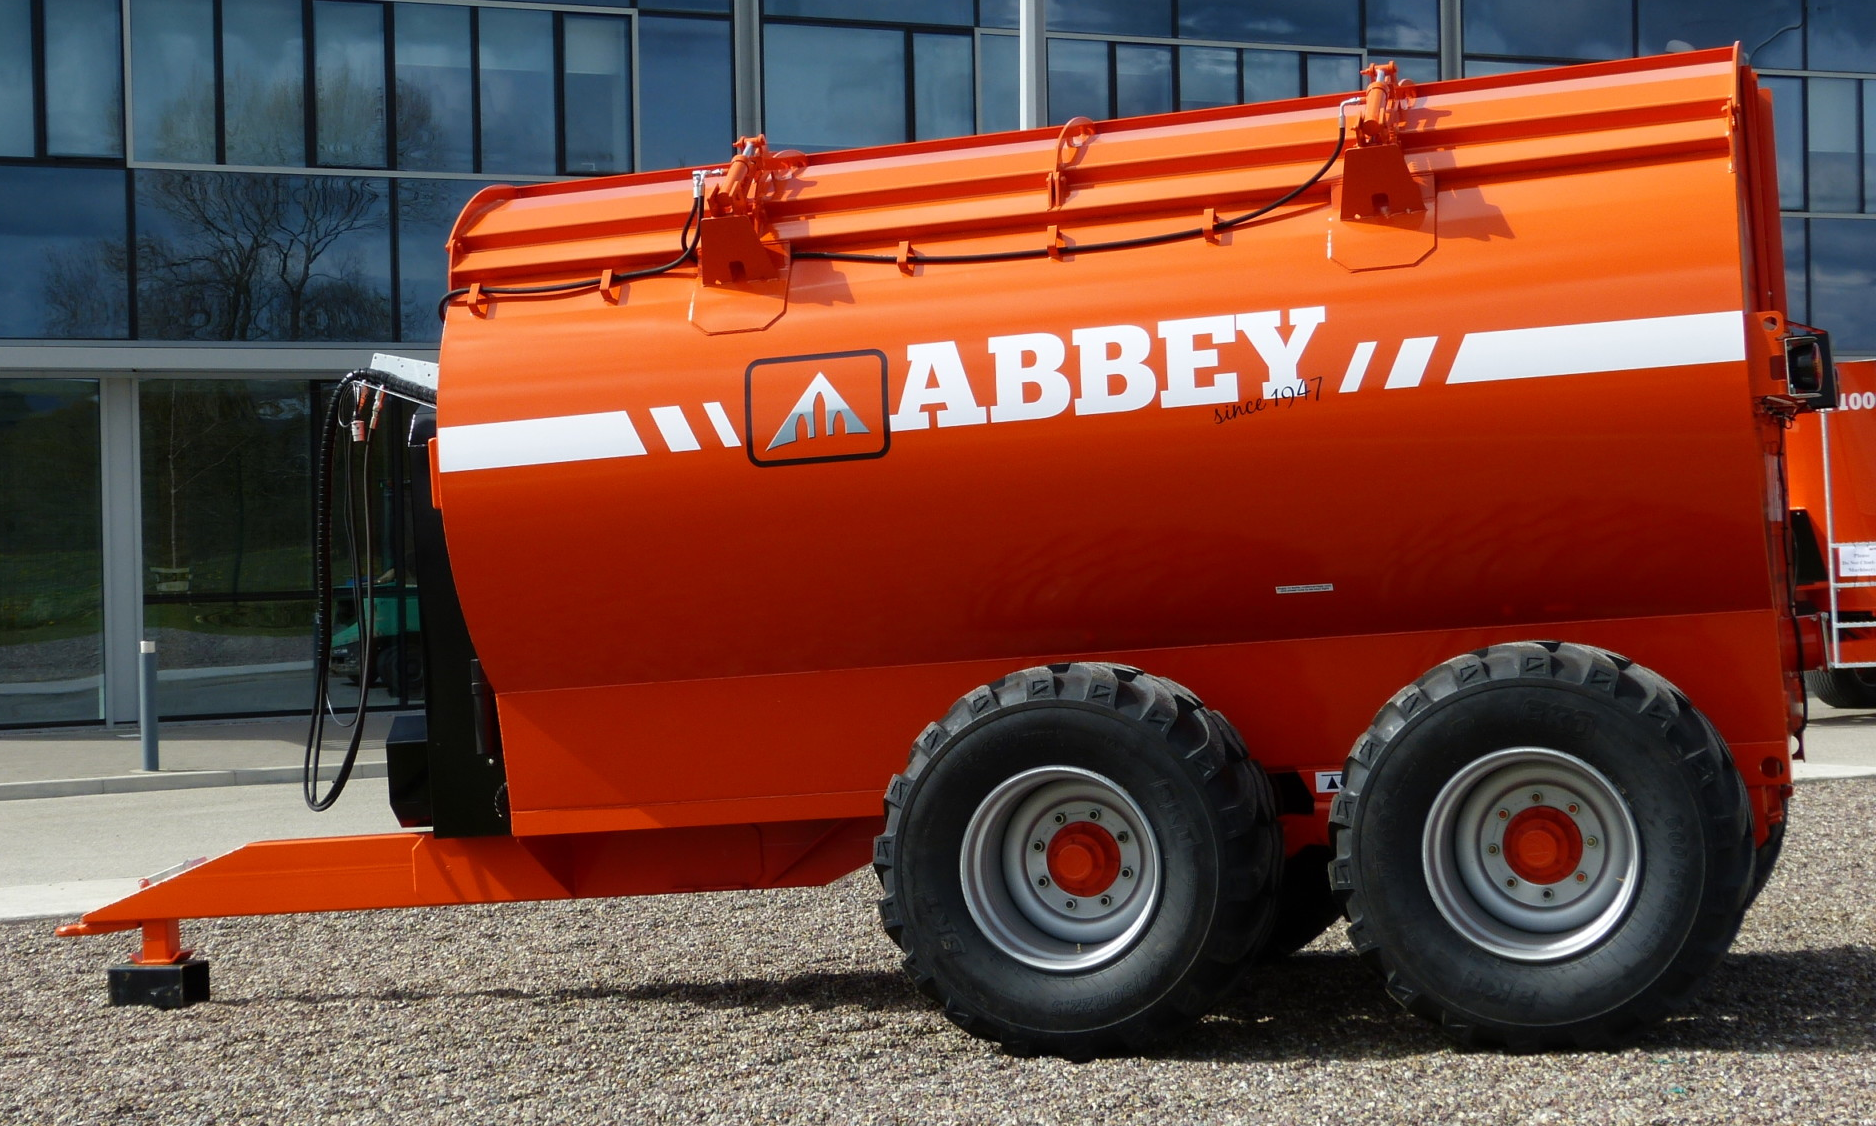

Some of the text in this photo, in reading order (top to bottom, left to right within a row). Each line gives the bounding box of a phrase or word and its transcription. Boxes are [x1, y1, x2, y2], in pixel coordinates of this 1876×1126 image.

[889, 306, 1325, 432] ABBEY
[1214, 376, 1322, 424] since 1947
